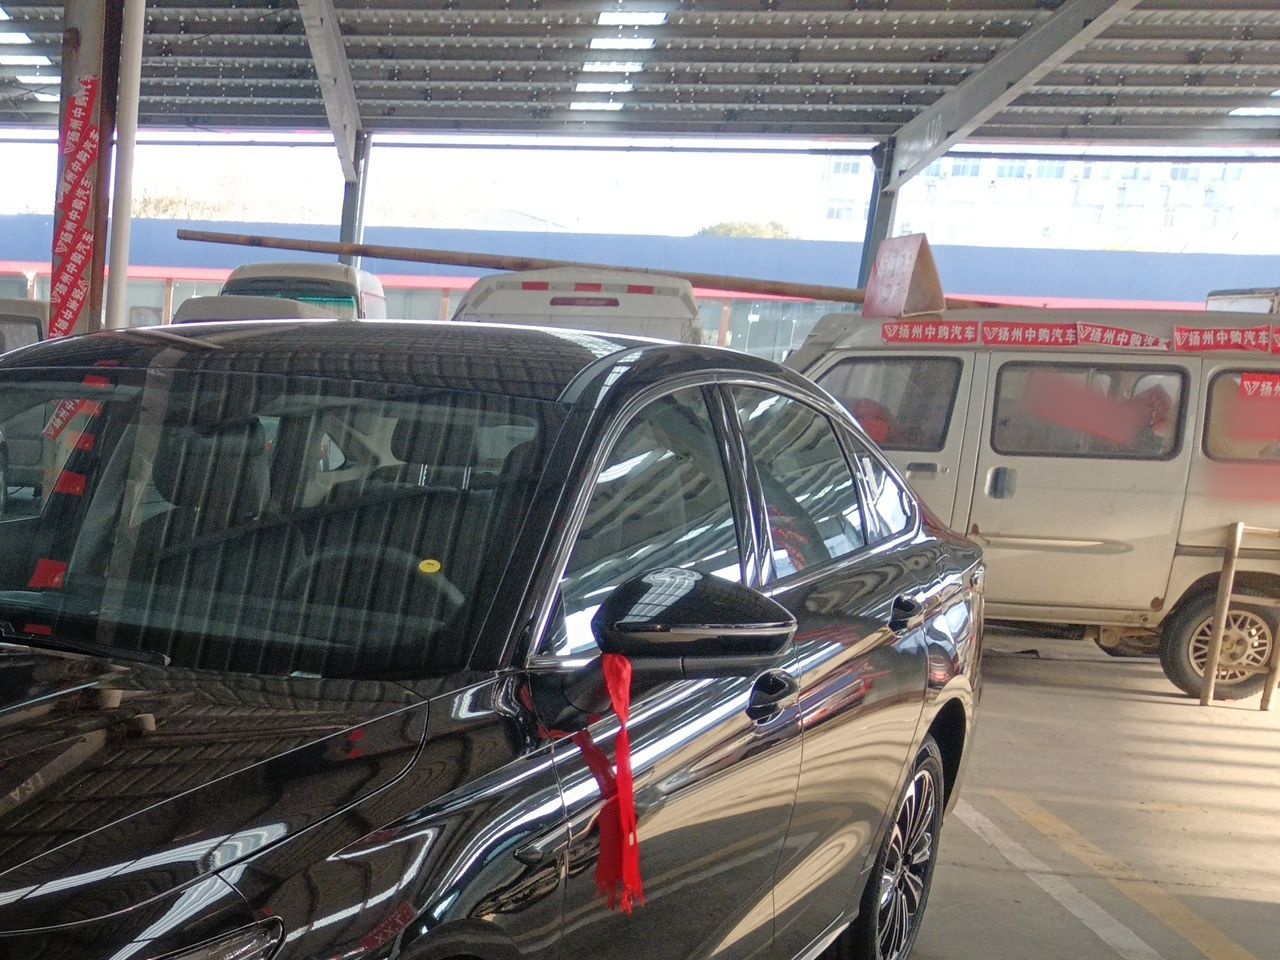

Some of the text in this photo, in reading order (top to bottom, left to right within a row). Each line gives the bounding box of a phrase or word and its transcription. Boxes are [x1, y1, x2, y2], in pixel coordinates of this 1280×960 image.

[61, 176, 94, 244] 扬州中购汽车
[55, 230, 94, 296] 扬州中购汽车
[898, 325, 976, 341] 扬州中购汽车
[997, 327, 1078, 344] 扬州中购汽车
[1189, 331, 1270, 347] 扬州中购汽车
